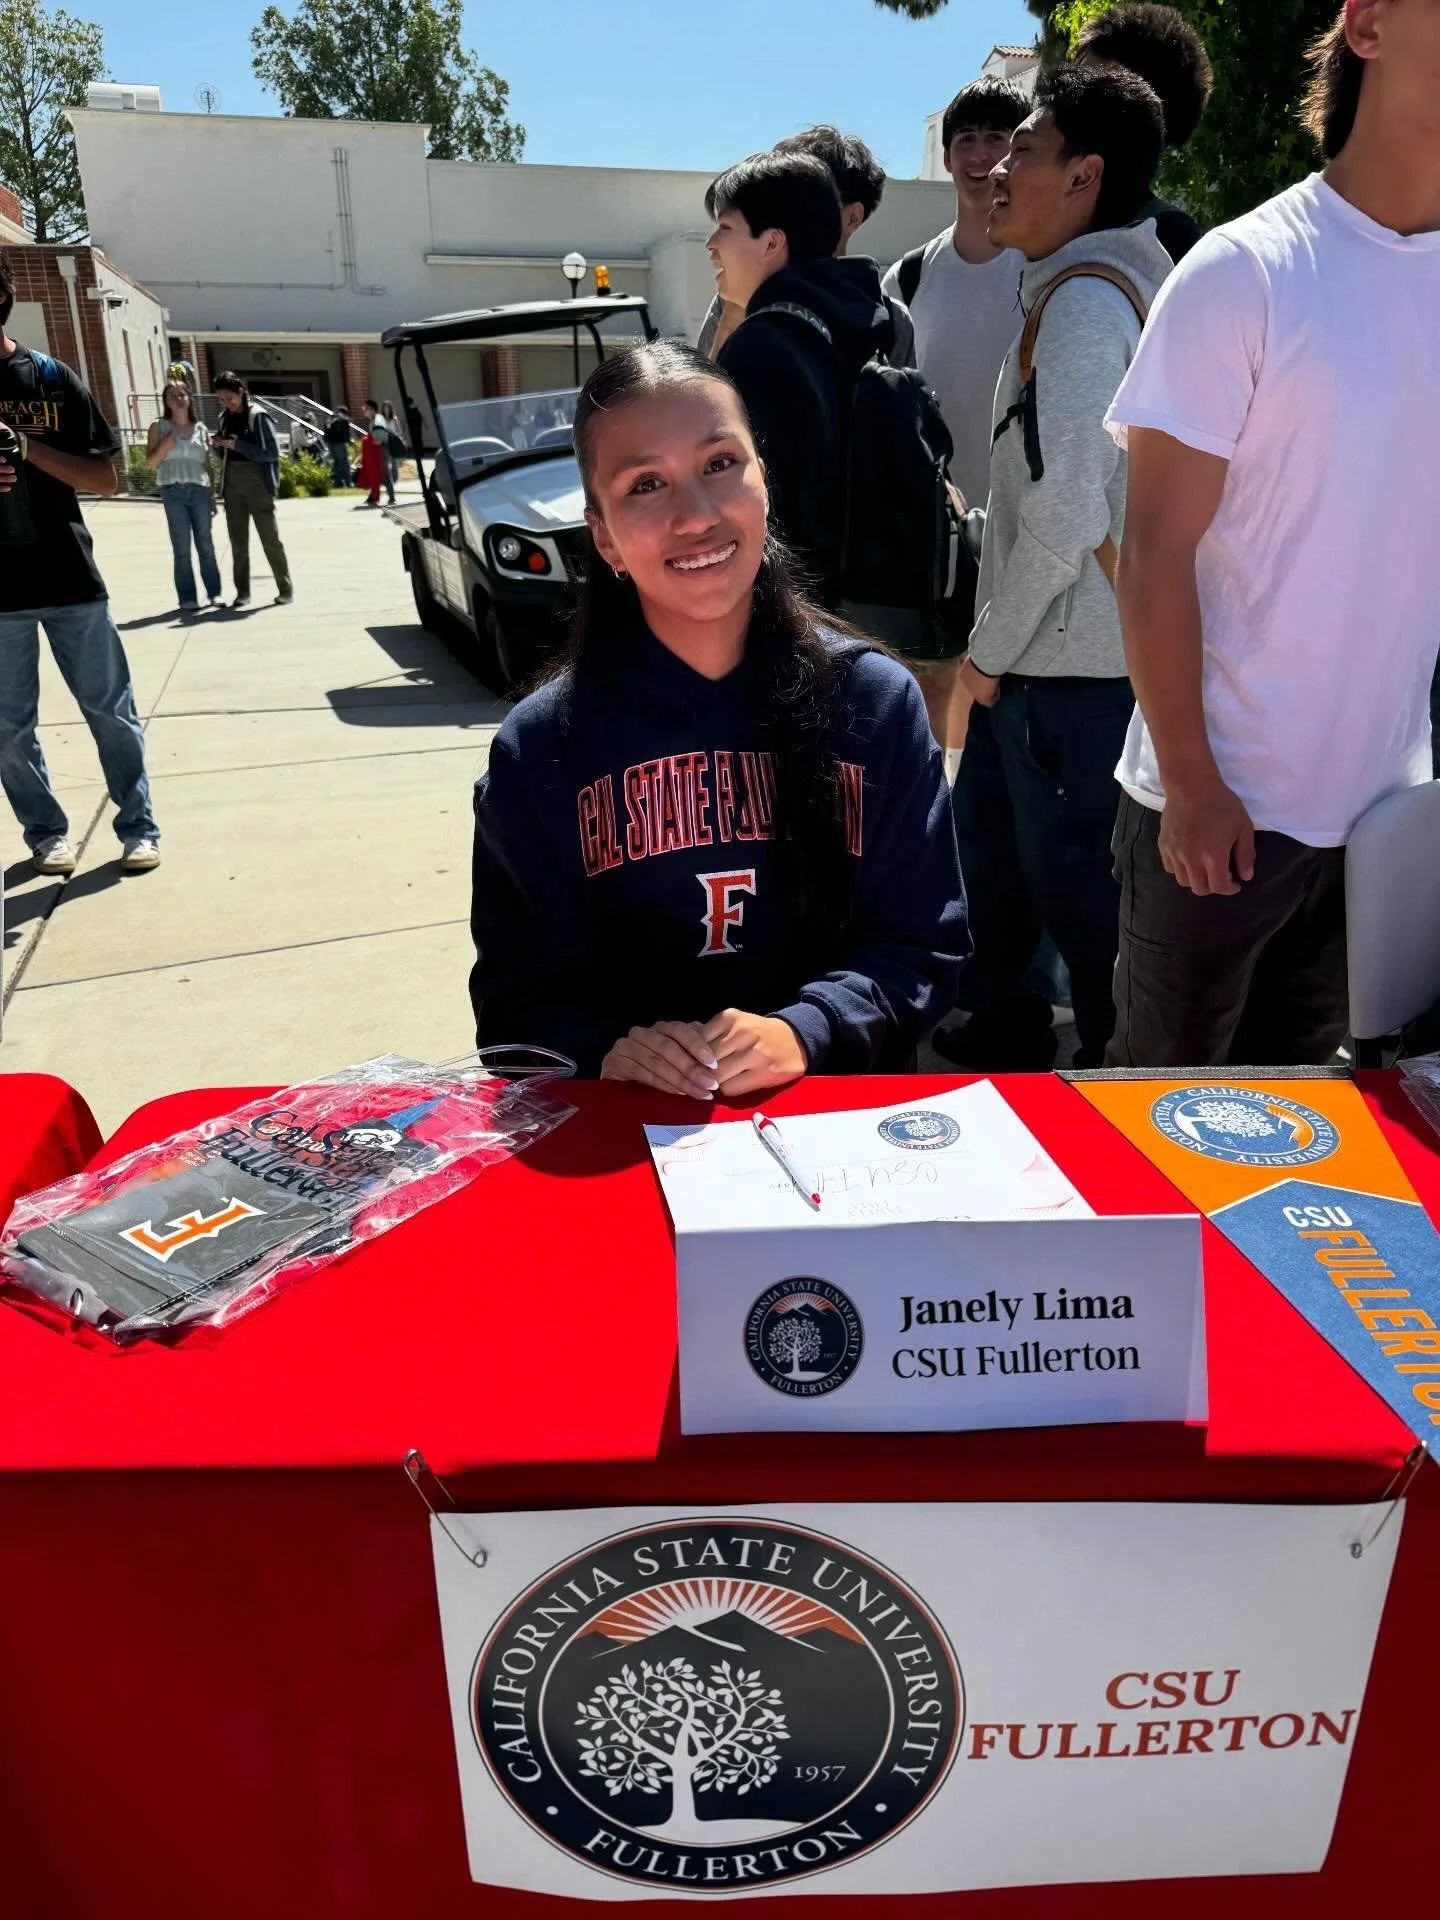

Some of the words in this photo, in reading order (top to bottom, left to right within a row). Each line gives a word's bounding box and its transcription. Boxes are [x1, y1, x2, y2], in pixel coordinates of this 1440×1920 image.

[577, 774, 624, 877] CAL
[624, 751, 713, 861] STATE
[695, 868, 757, 958] F
[1187, 1087, 1299, 1111] CALIFORNIA
[1155, 1101, 1208, 1152] FULLERTON
[1299, 1109, 1333, 1140] STATE
[1236, 1140, 1334, 1166] UNIVERSITY
[119, 1198, 267, 1262] F
[1283, 1206, 1353, 1228] CSU
[748, 1290, 780, 1361] CALIFORNIA
[782, 1281, 820, 1293] STATE
[824, 1287, 860, 1360] UNIVERSITY
[899, 1289, 1024, 1333] Janely
[1033, 1287, 1135, 1321] Lima
[770, 1372, 843, 1394] FULLERTON
[892, 1347, 967, 1379] CSU
[976, 1341, 1141, 1376] Fullerton
[492, 1565, 624, 1784] CALIFORNIA
[633, 1537, 797, 1577] STATE
[812, 1557, 942, 1787] UNIVERSITY
[1105, 1669, 1241, 1710] CSU
[967, 1709, 1357, 1760] FULLERTON
[793, 1764, 847, 1783] 1957
[582, 1820, 864, 1881] FULLERTON
